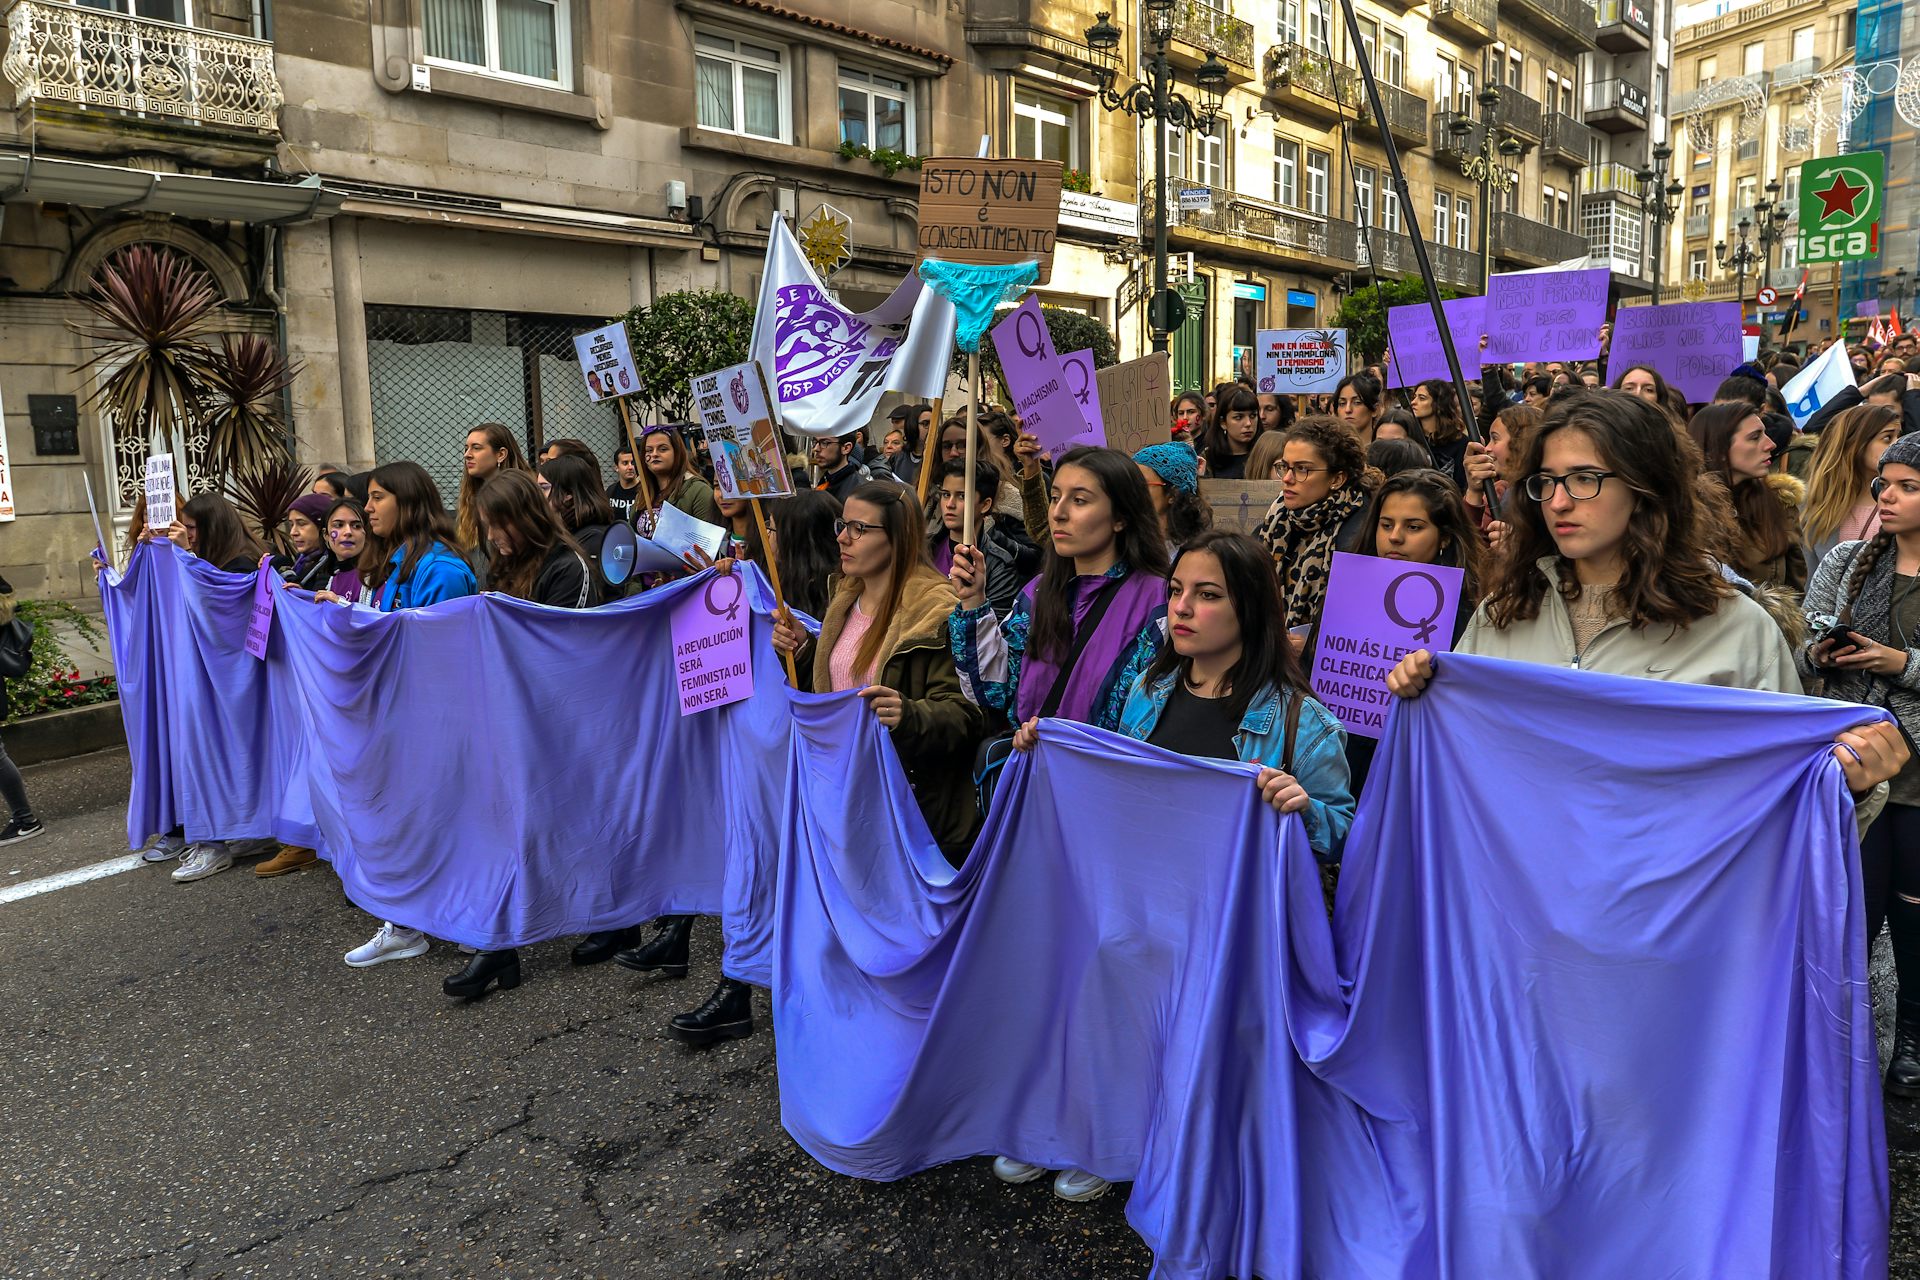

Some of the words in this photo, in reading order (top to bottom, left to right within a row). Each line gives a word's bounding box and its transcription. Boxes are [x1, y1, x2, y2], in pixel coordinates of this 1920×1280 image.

[1623, 97, 1643, 115] ABOGADOS
[925, 168, 976, 196] ISTO
[982, 169, 1037, 202] NON
[977, 202, 989, 222] é
[920, 225, 1055, 253] CONSENTIMENTO
[1799, 222, 1879, 261] isca!
[1272, 342, 1286, 350] NIN
[1288, 342, 1297, 350] EN
[1678, 327, 1705, 347] QUE
[1267, 351, 1280, 359] NIN
[1294, 350, 1335, 358] PAMPLONA
[1285, 358, 1324, 366] FEMINISMO
[783, 381, 814, 399] RSP
[819, 359, 850, 386] VIGO
[1277, 367, 1292, 375] NON
[1022, 378, 1059, 411] MACHISMO
[1022, 412, 1042, 432] MATA
[1120, 400, 1143, 435] QUE
[678, 645, 684, 657] A
[684, 626, 743, 655] REVOLUCIÓN
[1324, 635, 1357, 653] NON
[1359, 637, 1380, 658] ÁS
[680, 654, 703, 674] SERÁ
[1320, 657, 1392, 683] CLERICA
[681, 667, 731, 691] FEMINISTA
[732, 662, 746, 677] OU
[684, 693, 703, 709] NON
[704, 683, 729, 704] SERÁ
